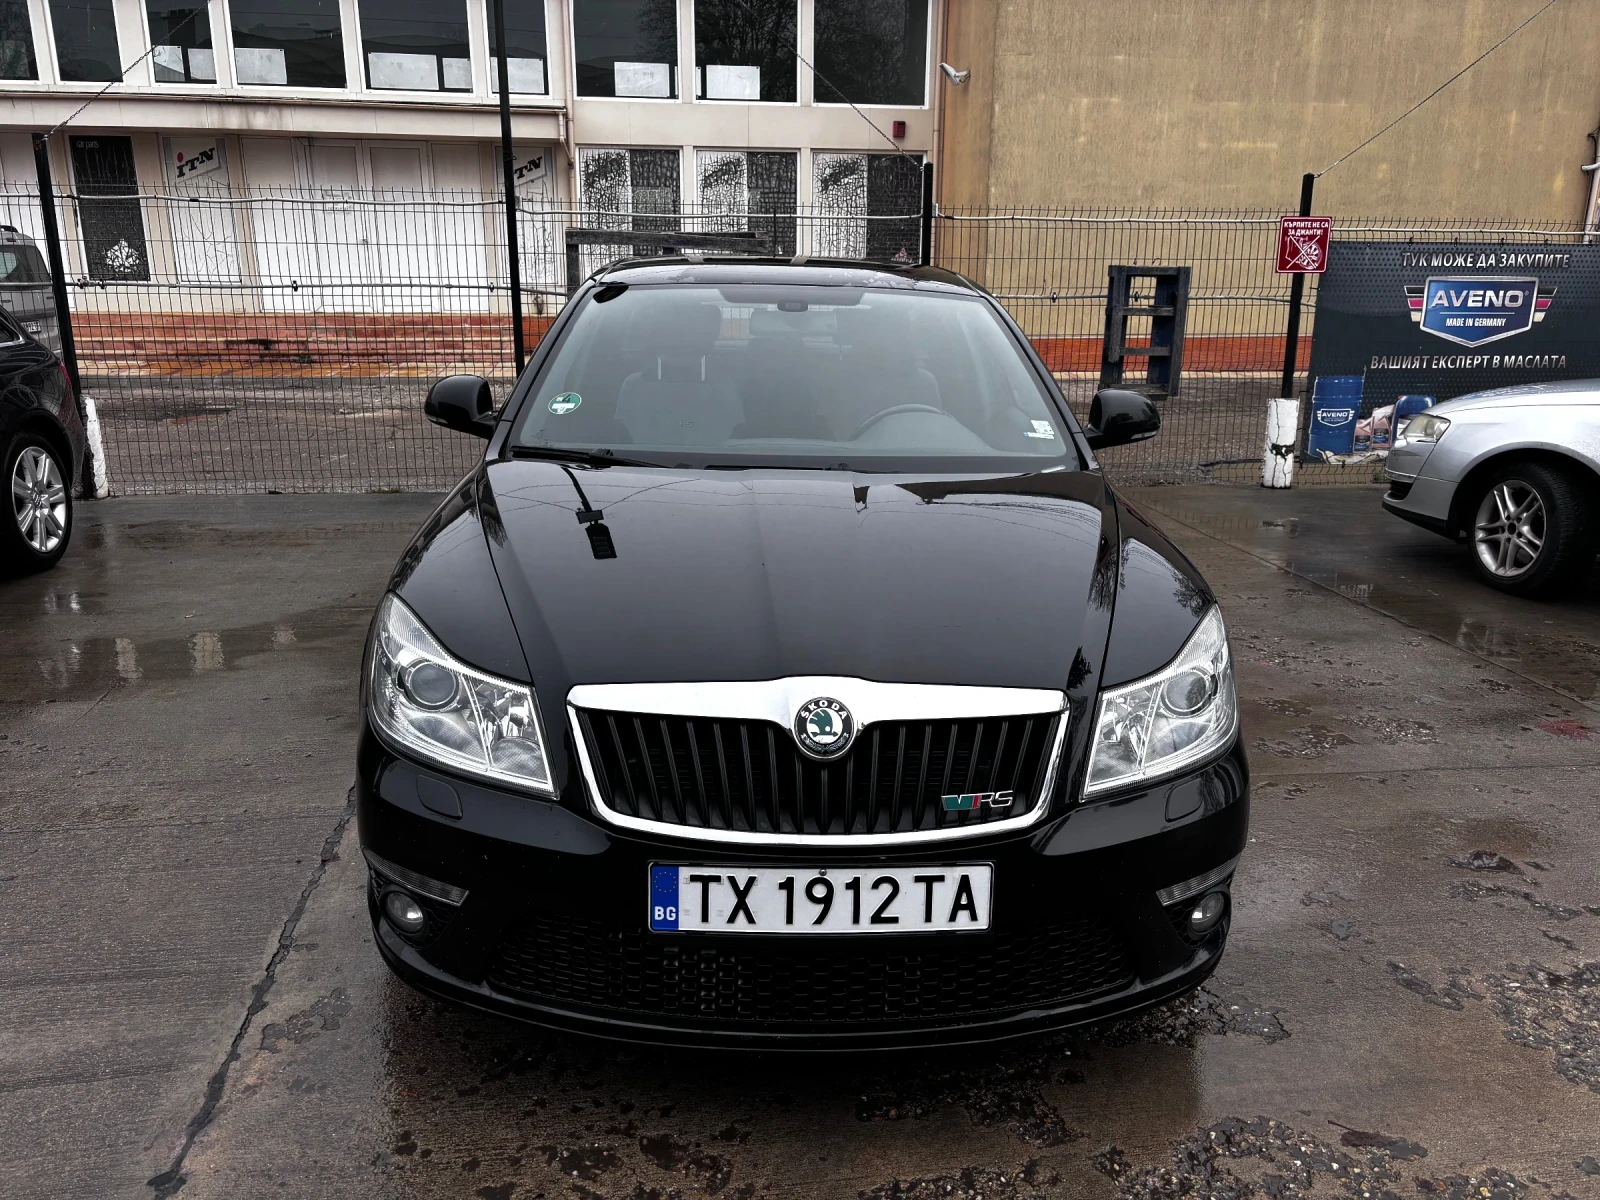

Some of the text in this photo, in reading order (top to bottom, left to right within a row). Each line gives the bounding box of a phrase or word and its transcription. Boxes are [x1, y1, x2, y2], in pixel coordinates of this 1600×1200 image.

[1402, 252, 1571, 269] ТУК МОЖЕ ДА ЗАКУПИТЕ
[1446, 317, 1507, 327] MADE IN GERMANY
[1370, 355, 1566, 369] ВАШИЯТ ЕКСПЕРТ В МАСЛАТА
[689, 873, 979, 926] TX 1912 TA
[654, 906, 676, 921] BG
